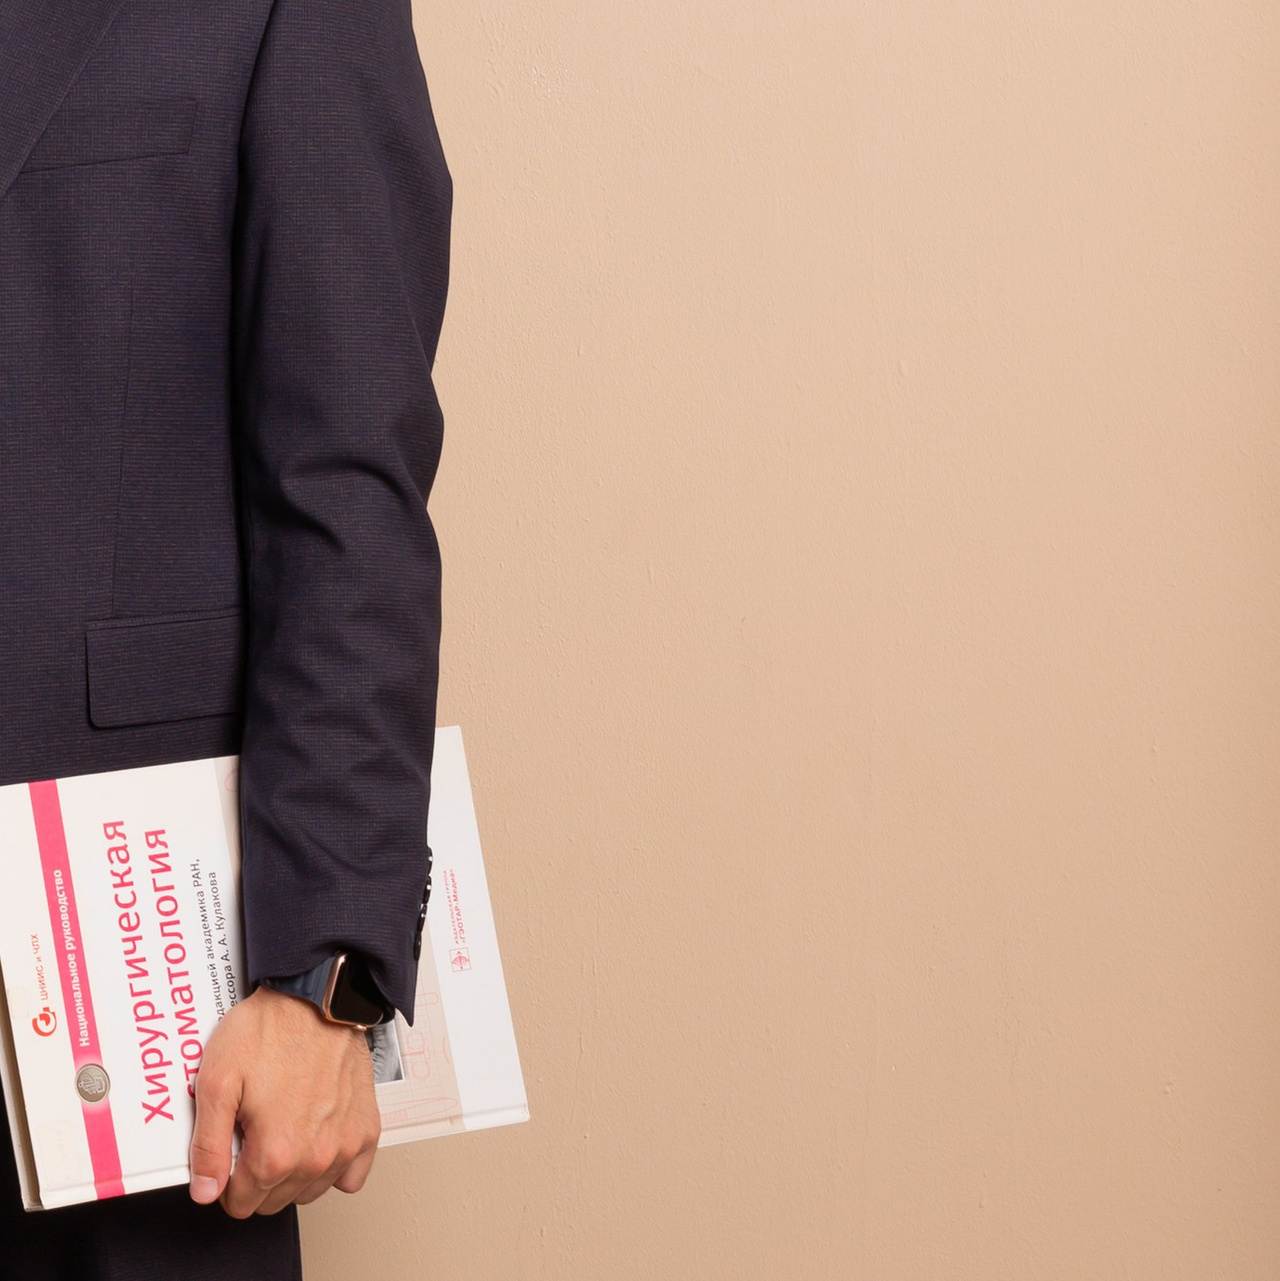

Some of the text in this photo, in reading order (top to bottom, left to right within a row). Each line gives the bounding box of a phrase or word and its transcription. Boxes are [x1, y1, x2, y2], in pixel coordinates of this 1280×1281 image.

[53, 869, 91, 1047] Национальное руководство
[102, 820, 176, 1125] Хирургическая
[190, 858, 225, 1022] дакцией академика РАН,
[207, 871, 225, 931] Кулакова
[33, 967, 49, 1002] ЦНИИС
